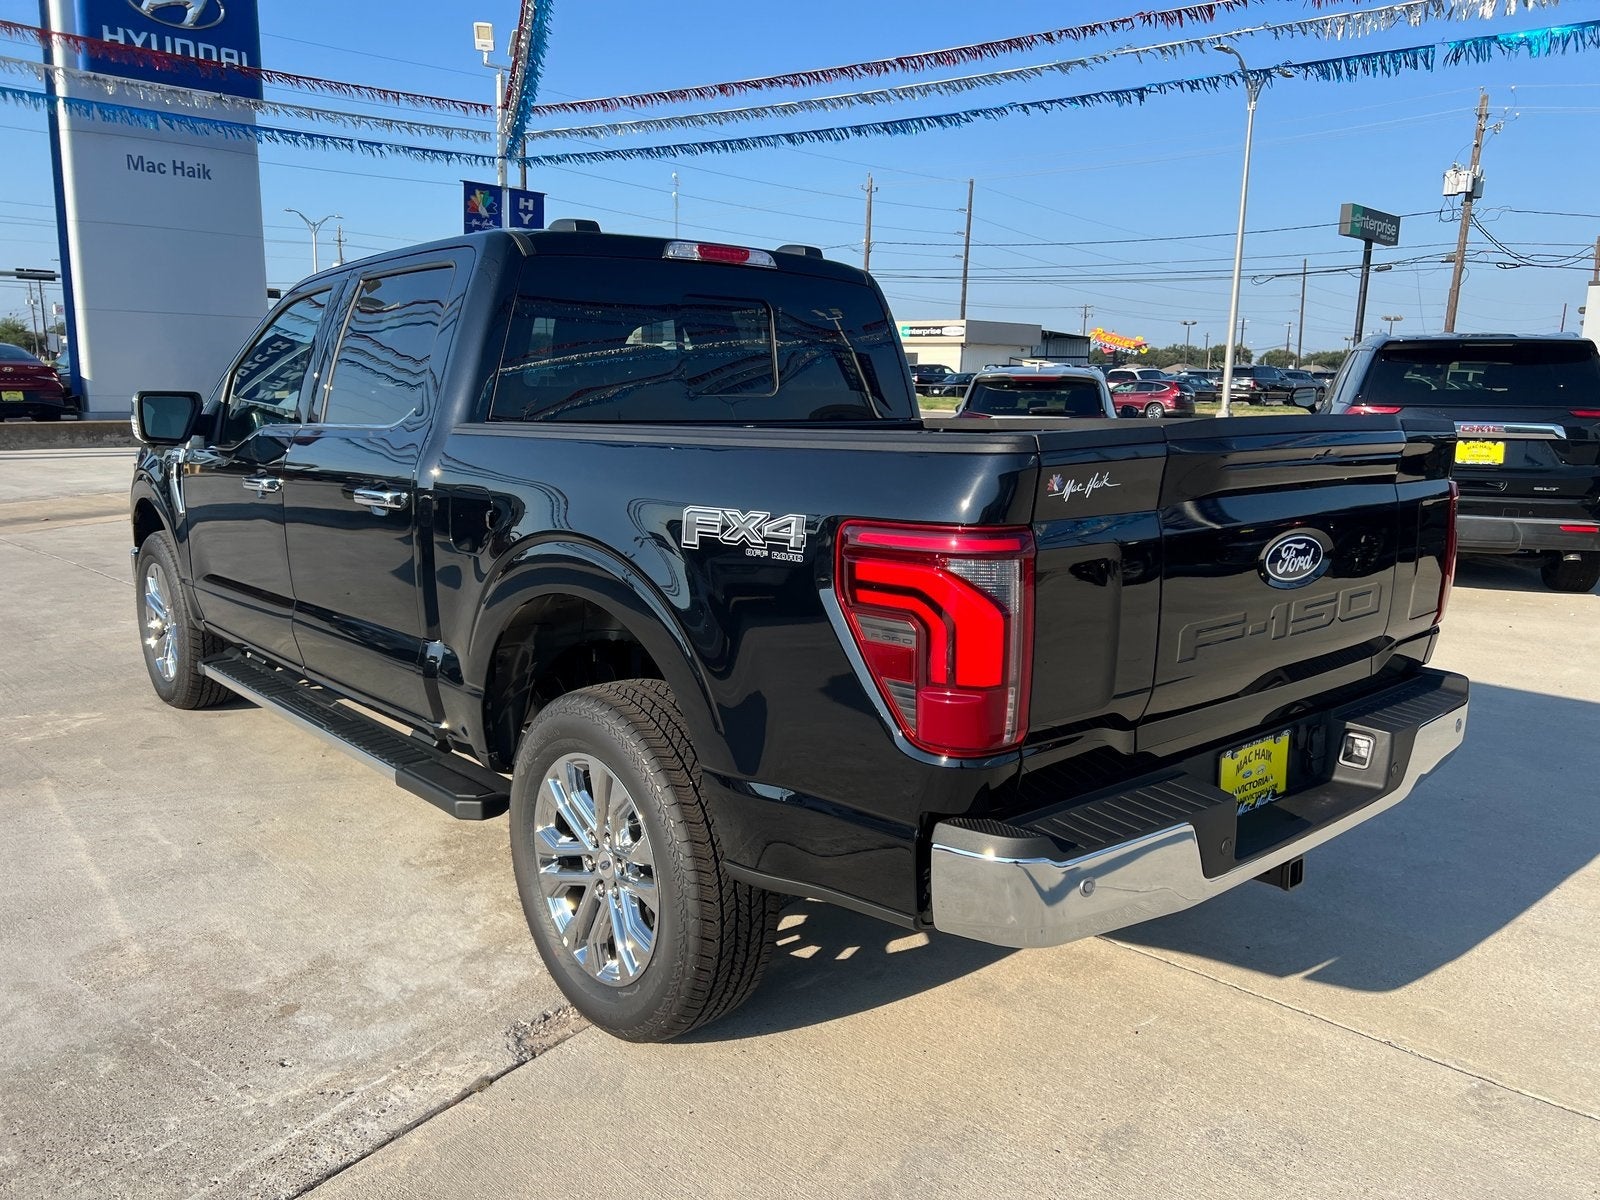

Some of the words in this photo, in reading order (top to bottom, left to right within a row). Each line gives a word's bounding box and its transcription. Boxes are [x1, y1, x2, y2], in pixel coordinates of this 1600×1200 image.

[102, 24, 249, 69] HYUNDAI
[126, 154, 167, 175] Mac
[172, 159, 212, 181] Haik
[1354, 212, 1397, 236] enterprise
[903, 327, 941, 336] enterprise
[1089, 327, 1136, 349] Premier
[1048, 479, 1085, 502] Mac
[1084, 471, 1121, 498] Haik
[681, 505, 806, 553] FX4
[745, 548, 769, 557] OFF
[771, 551, 804, 563] ROAD
[1276, 542, 1314, 575] Ford
[1177, 582, 1382, 663] F-150
[871, 632, 913, 645] FORD
[1236, 751, 1253, 776] MAC
[1254, 748, 1273, 763] HAIK
[1237, 774, 1270, 794] VICTORIA
